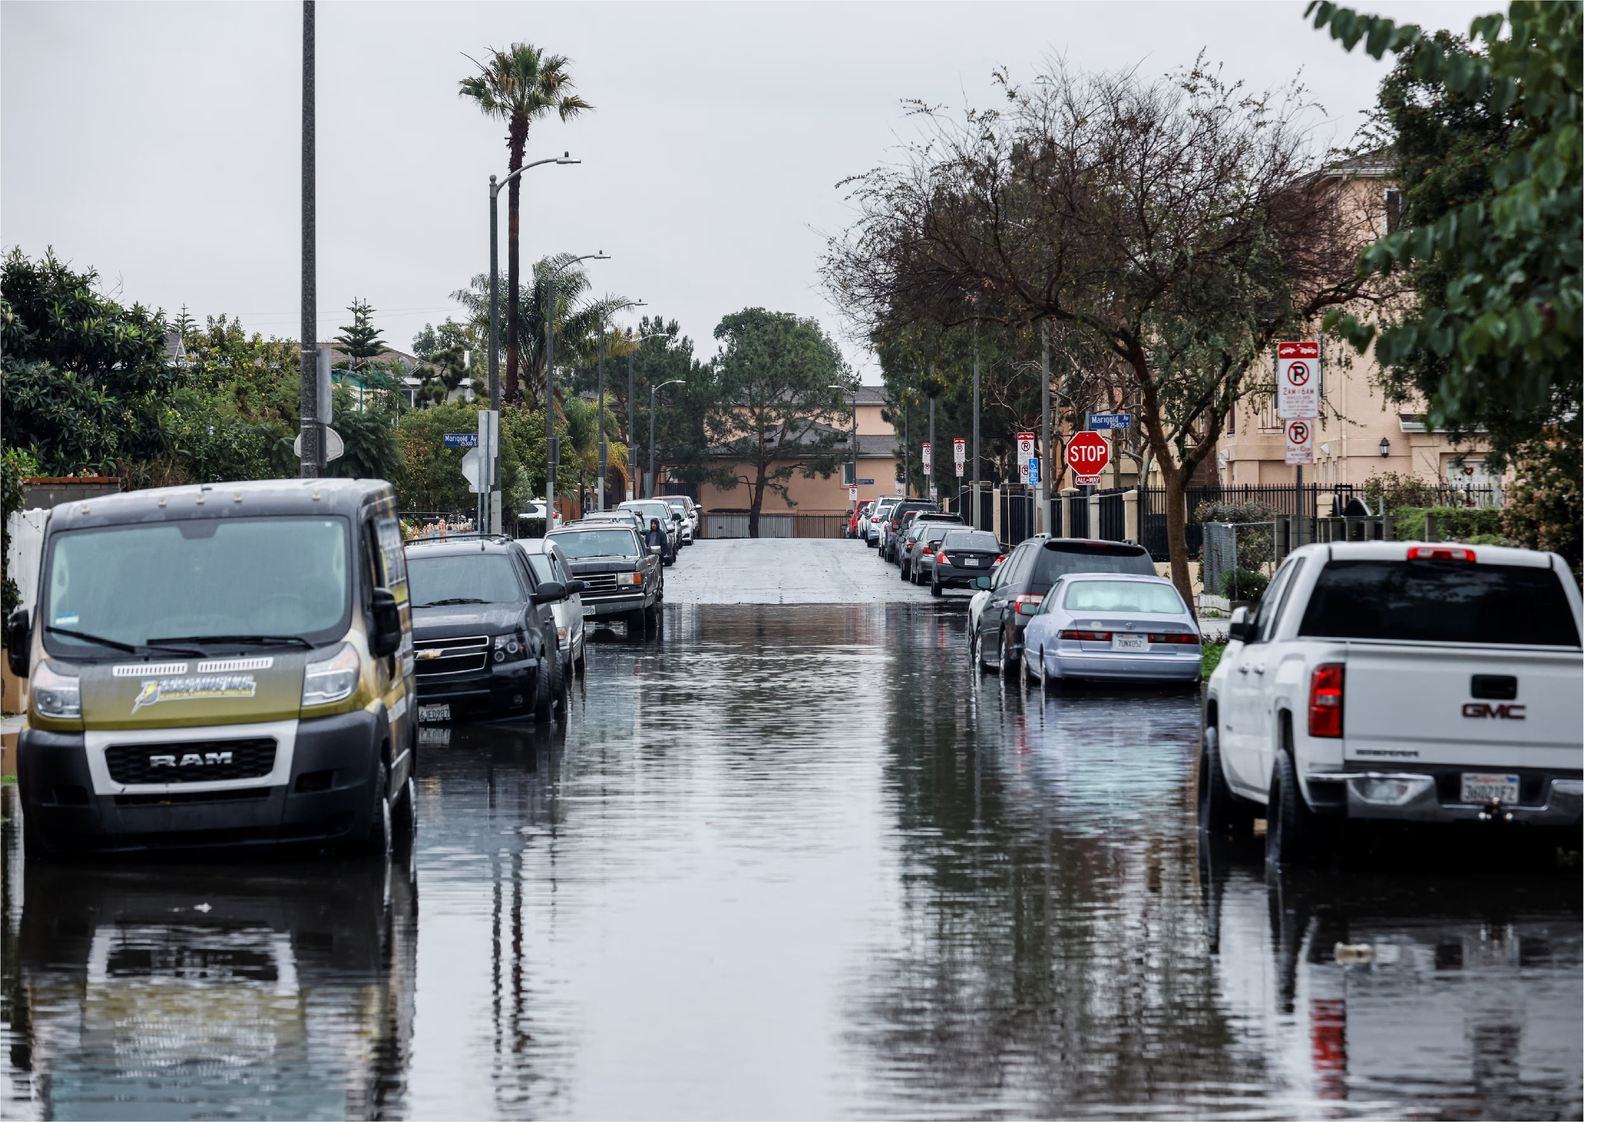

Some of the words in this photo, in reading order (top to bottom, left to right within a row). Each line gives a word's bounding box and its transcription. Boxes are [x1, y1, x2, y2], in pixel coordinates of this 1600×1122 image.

[1283, 387, 1296, 395] 2AM
[1302, 387, 1314, 395] 6AM
[1092, 416, 1118, 426] Marigold
[445, 435, 467, 443] Marigold
[1070, 445, 1106, 462] STOP
[1462, 703, 1526, 720] GMC
[149, 752, 232, 767] RAM
